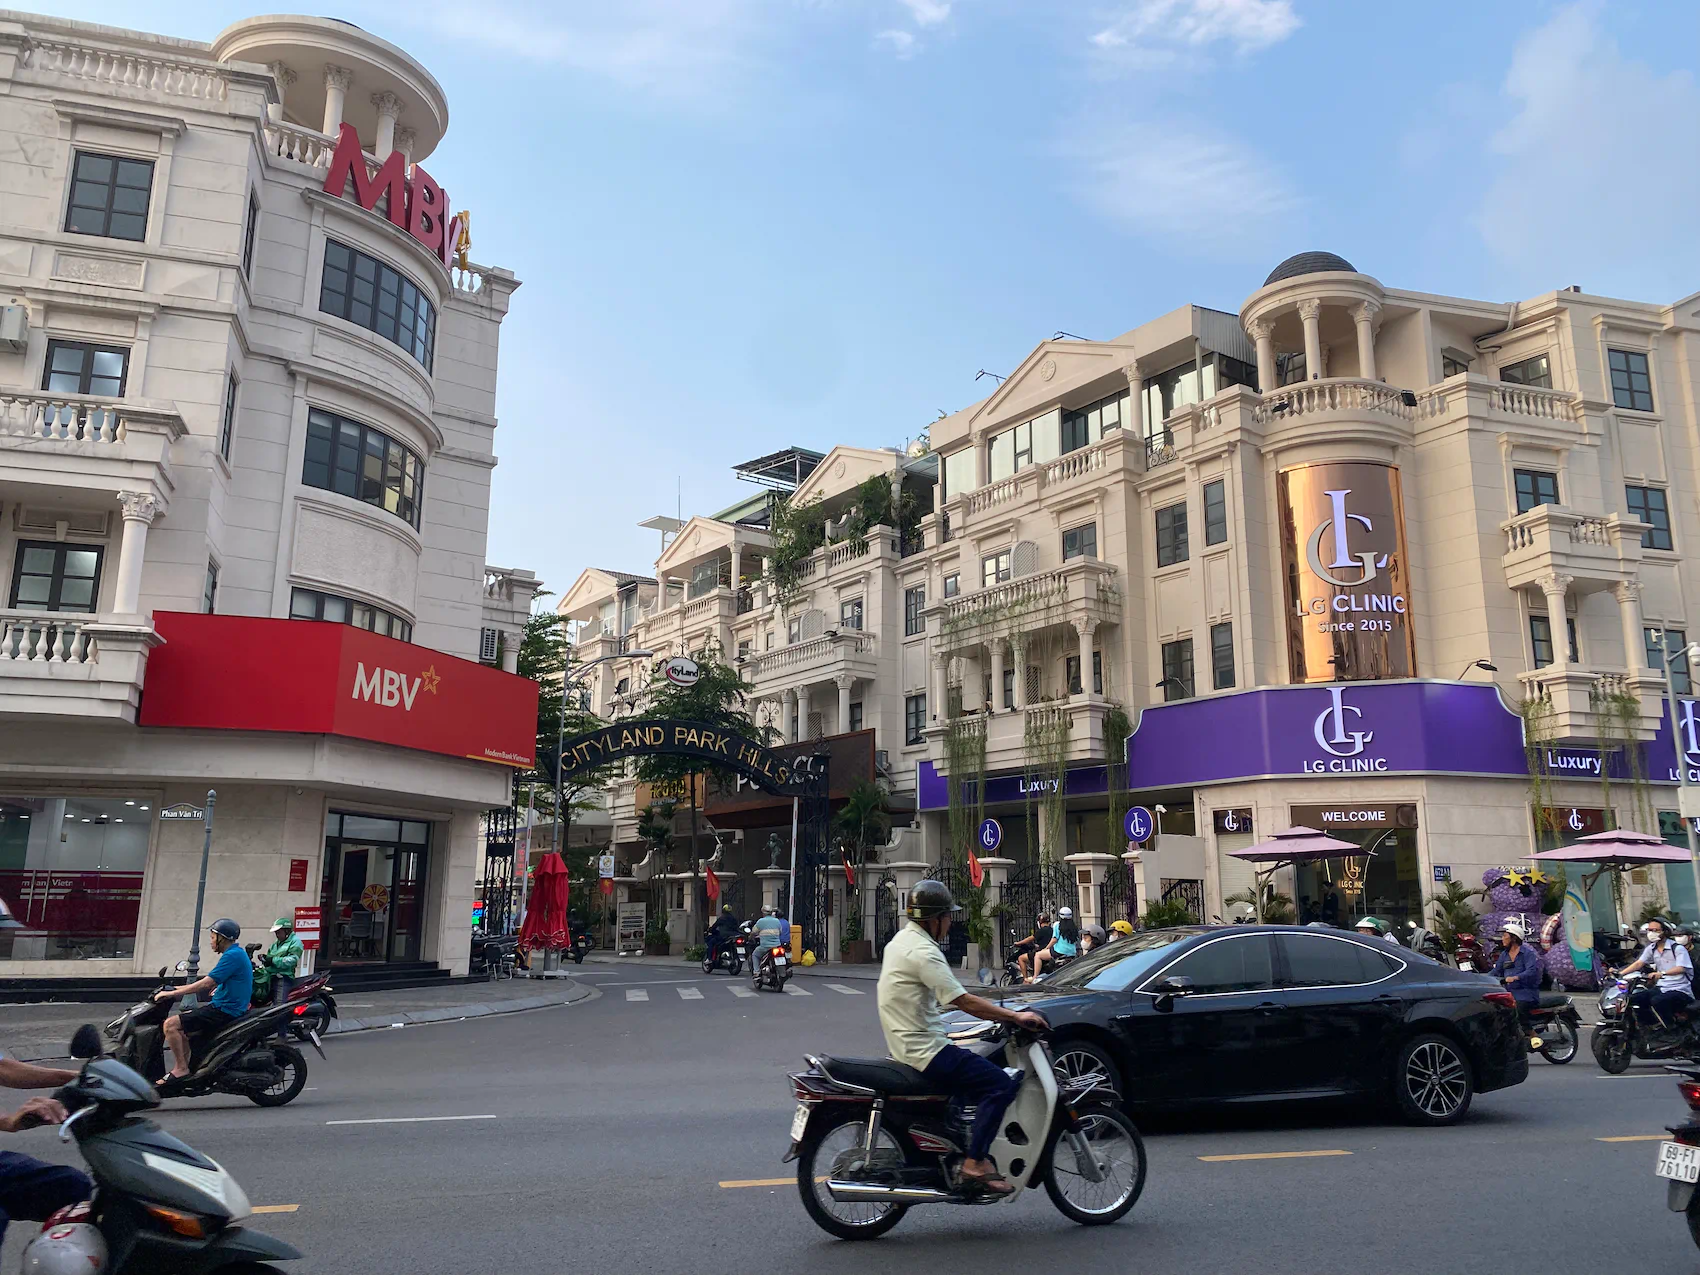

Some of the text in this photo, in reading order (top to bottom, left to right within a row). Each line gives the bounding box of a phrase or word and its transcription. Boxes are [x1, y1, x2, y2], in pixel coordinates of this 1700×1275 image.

[323, 122, 463, 271] MBV
[1296, 594, 1406, 617] LG CLINIC
[1318, 619, 1392, 633] Since 2015
[351, 661, 422, 711] MBV
[559, 726, 665, 771] CITYLAND
[674, 727, 731, 755] PARK
[737, 743, 789, 785] HILLS
[1303, 758, 1388, 773] LG CLINIC
[1548, 751, 1602, 774] Luxury
[1020, 779, 1059, 793] Luxury
[161, 810, 178, 818] Phan
[1321, 811, 1387, 822] WELCOME
[1666, 1145, 1696, 1164] 69-F1
[1659, 1159, 1697, 1180] 761.10
